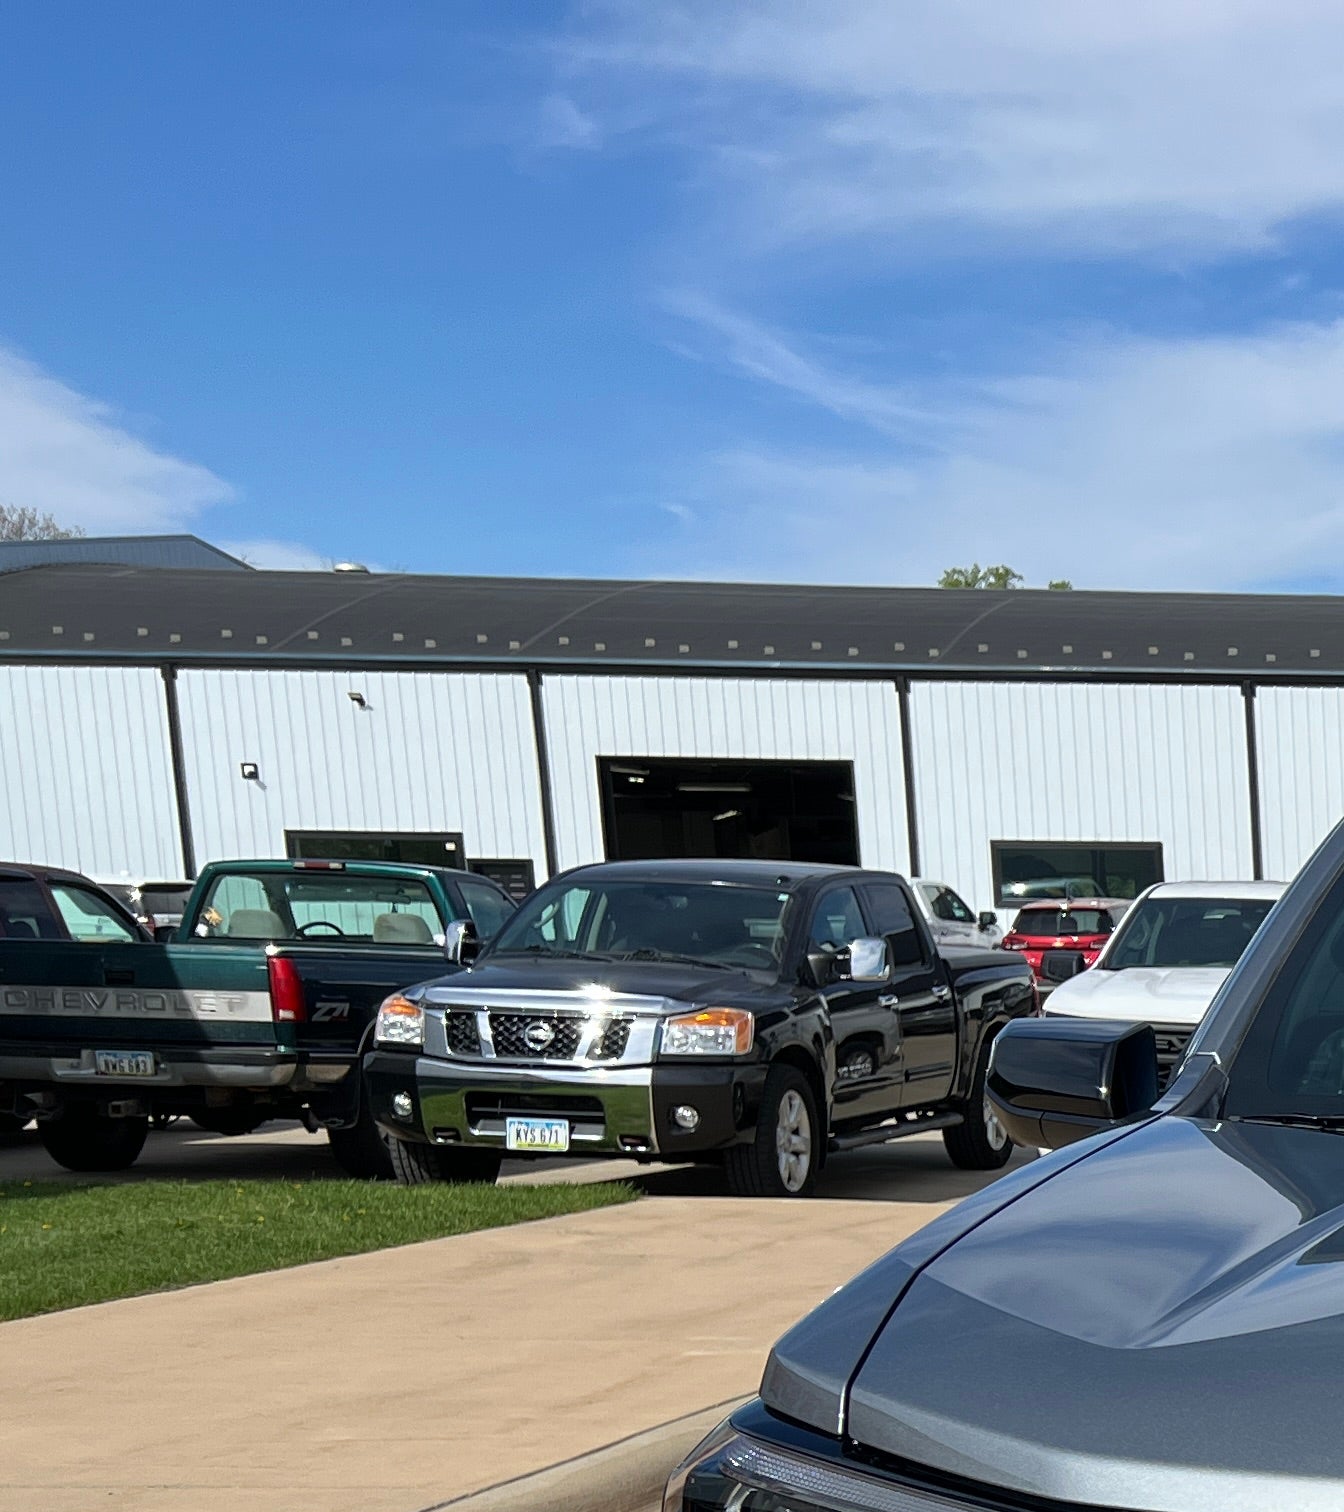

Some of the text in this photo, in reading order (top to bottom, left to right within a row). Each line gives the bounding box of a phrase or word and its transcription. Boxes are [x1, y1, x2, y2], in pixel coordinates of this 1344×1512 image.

[3, 990, 243, 1014] CHEVROLET
[312, 1002, 350, 1022] Z71
[515, 1127, 536, 1143] KYS
